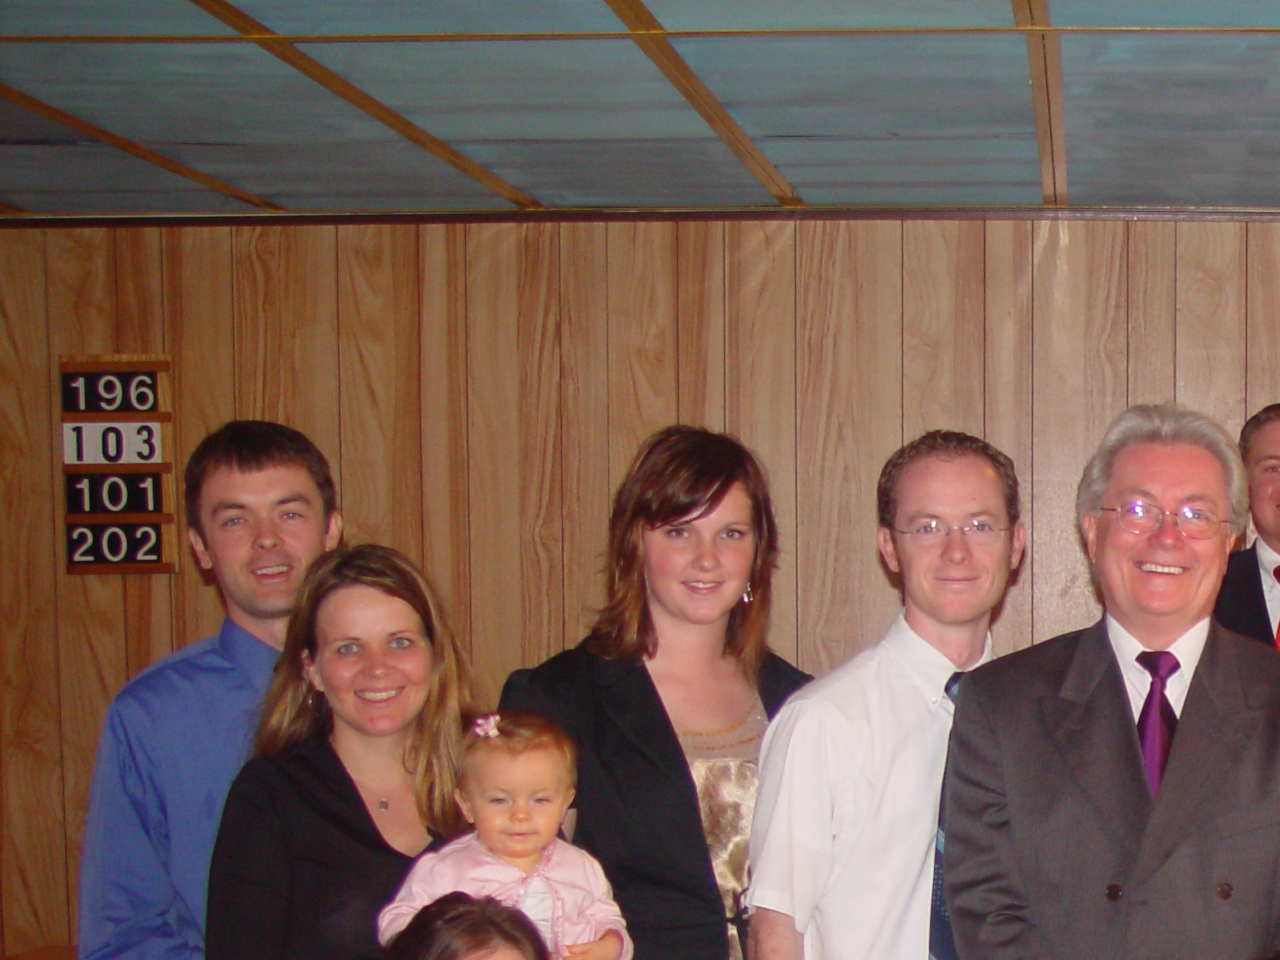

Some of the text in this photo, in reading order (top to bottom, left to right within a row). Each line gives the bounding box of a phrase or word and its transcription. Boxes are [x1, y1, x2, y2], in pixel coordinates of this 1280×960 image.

[71, 375, 154, 411] 196
[72, 425, 156, 462] 103
[75, 476, 155, 512] 101
[72, 526, 158, 563] 202
